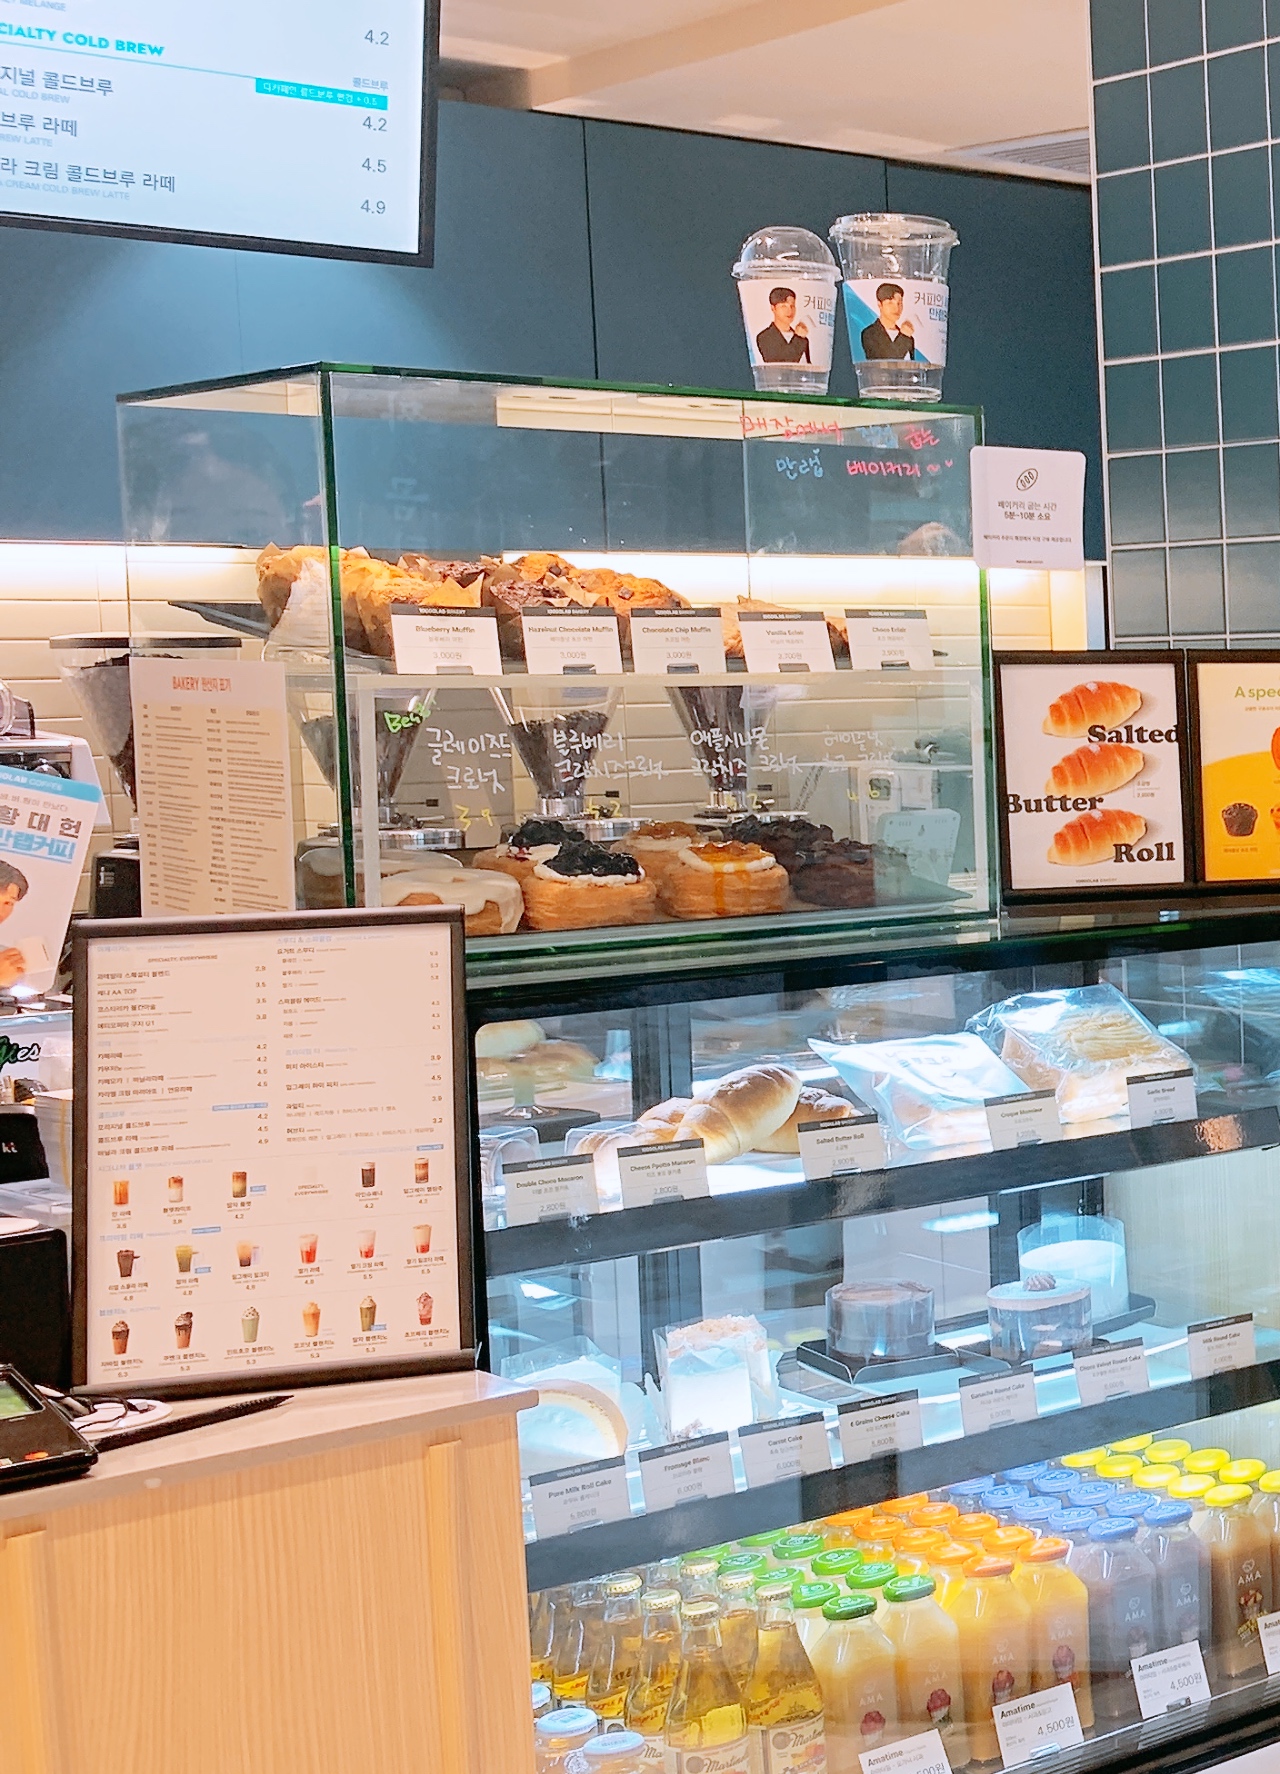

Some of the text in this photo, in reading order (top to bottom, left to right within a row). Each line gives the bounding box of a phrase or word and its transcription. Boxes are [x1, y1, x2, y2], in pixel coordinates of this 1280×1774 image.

[63, 32, 109, 49] COLD
[115, 39, 165, 57] BREW
[364, 29, 389, 46] 4.2
[42, 71, 114, 96] 콜드브루
[0, 111, 77, 137] 브루 라떼
[362, 116, 387, 132] 4.2
[361, 157, 387, 173] 4.5
[24, 160, 59, 180] 크림
[65, 164, 135, 188] 콜드브루
[143, 173, 175, 193] 라떼
[360, 199, 386, 215] 4.9
[415, 625, 475, 634] Blueberry Muffin
[559, 626, 590, 634] Chocolate
[592, 626, 613, 634] Muffin
[642, 626, 673, 634] Chocolate
[674, 626, 690, 635] Chip
[172, 676, 199, 690] BAKERY
[1234, 686, 1246, 698] A
[1087, 724, 1179, 744] Salted
[1007, 793, 1104, 814] Butter
[1113, 842, 1176, 863] Roll
[672, 1158, 696, 1168] Macaron
[516, 1179, 537, 1189] Double
[558, 1174, 584, 1184] Macaron
[788, 1434, 803, 1444] Cake
[664, 1456, 711, 1473] Fromage Blanc
[565, 1485, 580, 1495] Milk
[581, 1482, 594, 1491] Roll
[595, 1478, 612, 1488] Cake
[1238, 1573, 1262, 1586] AMA
[1176, 1594, 1200, 1608] AMA
[1125, 1610, 1147, 1622] AMA
[1138, 1657, 1168, 1673] Amatime
[1170, 1672, 1202, 1691] 4,500원
[1000, 1701, 1036, 1720] Amatime
[1037, 1715, 1075, 1737] 4,500원
[868, 1750, 904, 1767] Amatime
